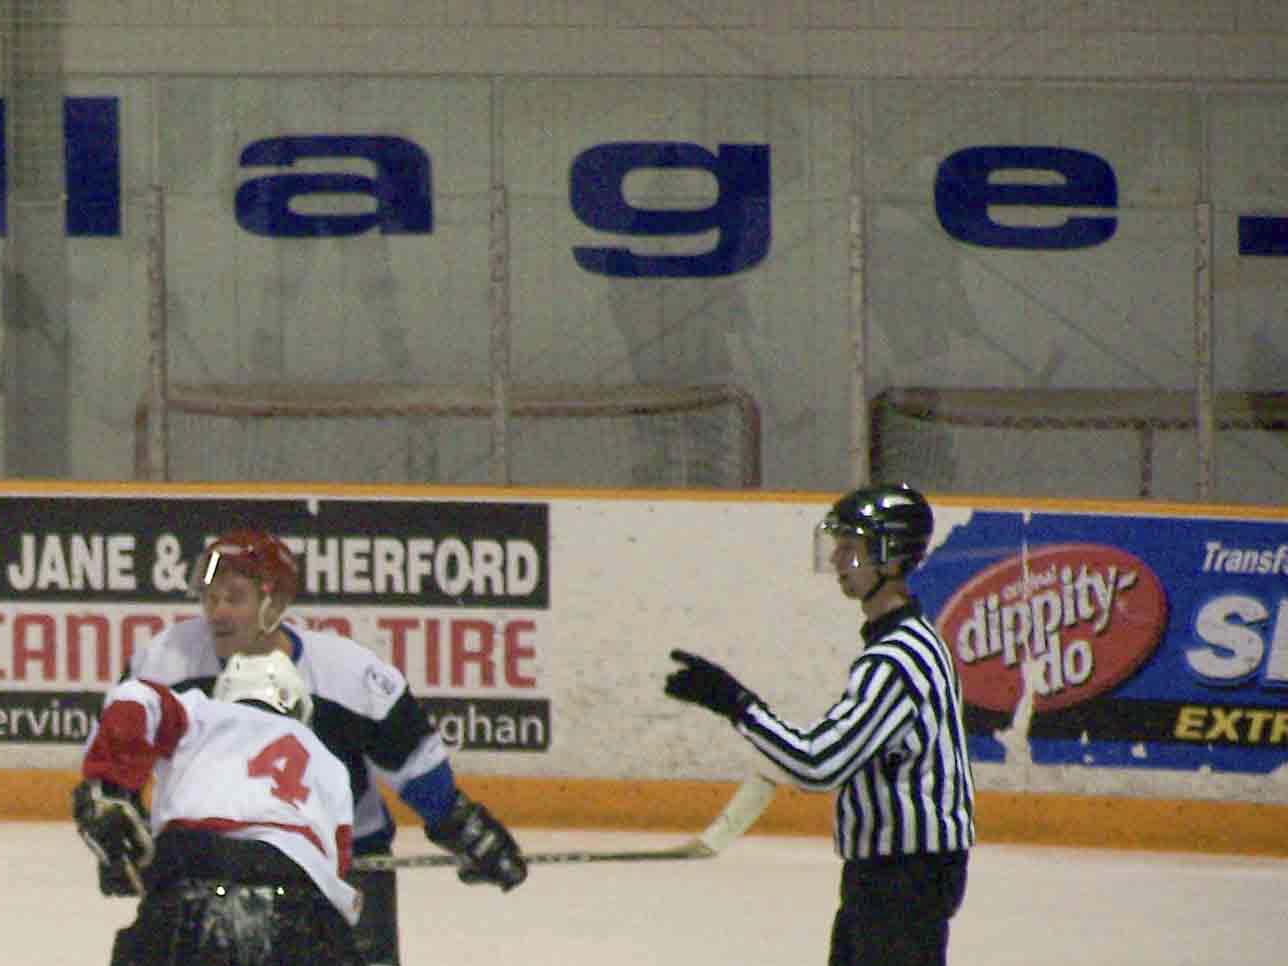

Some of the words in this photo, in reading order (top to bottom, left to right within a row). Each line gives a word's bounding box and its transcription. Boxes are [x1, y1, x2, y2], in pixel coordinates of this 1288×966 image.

[8, 535, 135, 591] JANE
[152, 533, 190, 593] &
[377, 618, 537, 688] TIRE
[428, 703, 544, 751] ghan
[247, 733, 311, 806] 4
